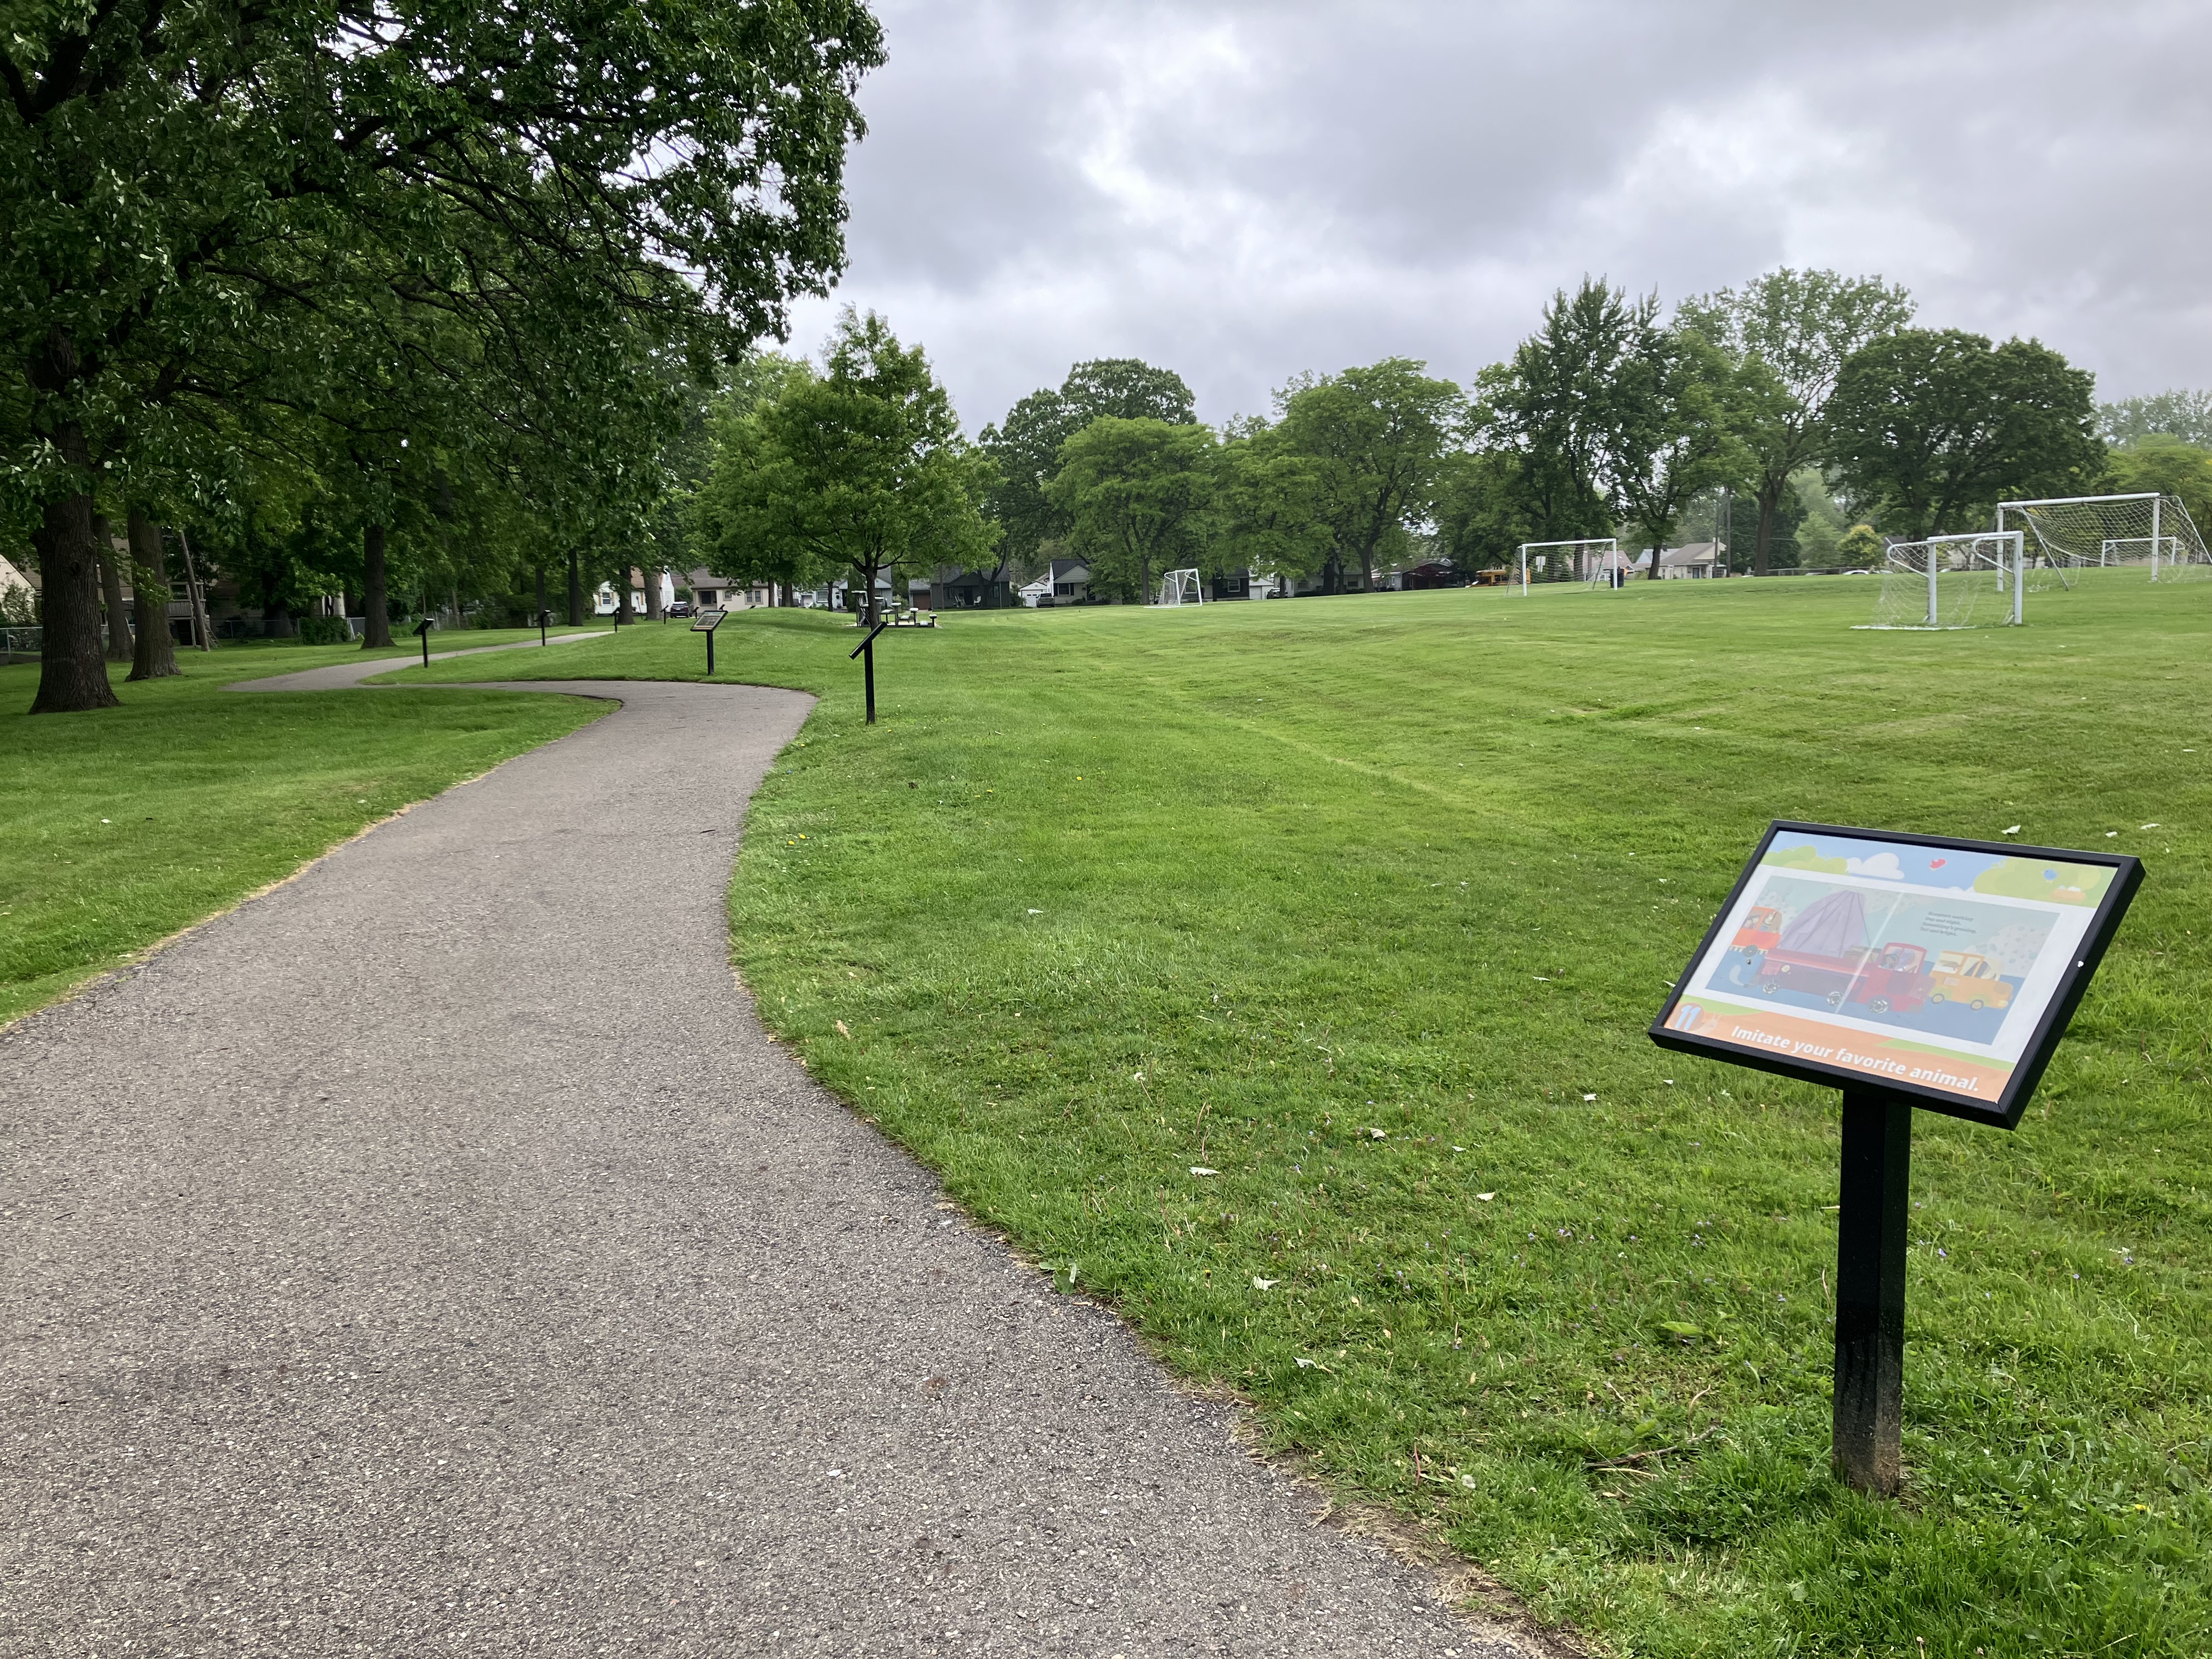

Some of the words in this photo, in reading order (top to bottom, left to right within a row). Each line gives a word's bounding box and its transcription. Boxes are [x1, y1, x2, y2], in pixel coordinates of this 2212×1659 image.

[1675, 1005, 1701, 1031] 11
[1731, 1025, 1791, 1049] Imitate
[1790, 1041, 1833, 1058] your
[1836, 1048, 1906, 1075] favorite
[1909, 1067, 1979, 1092] animal.
